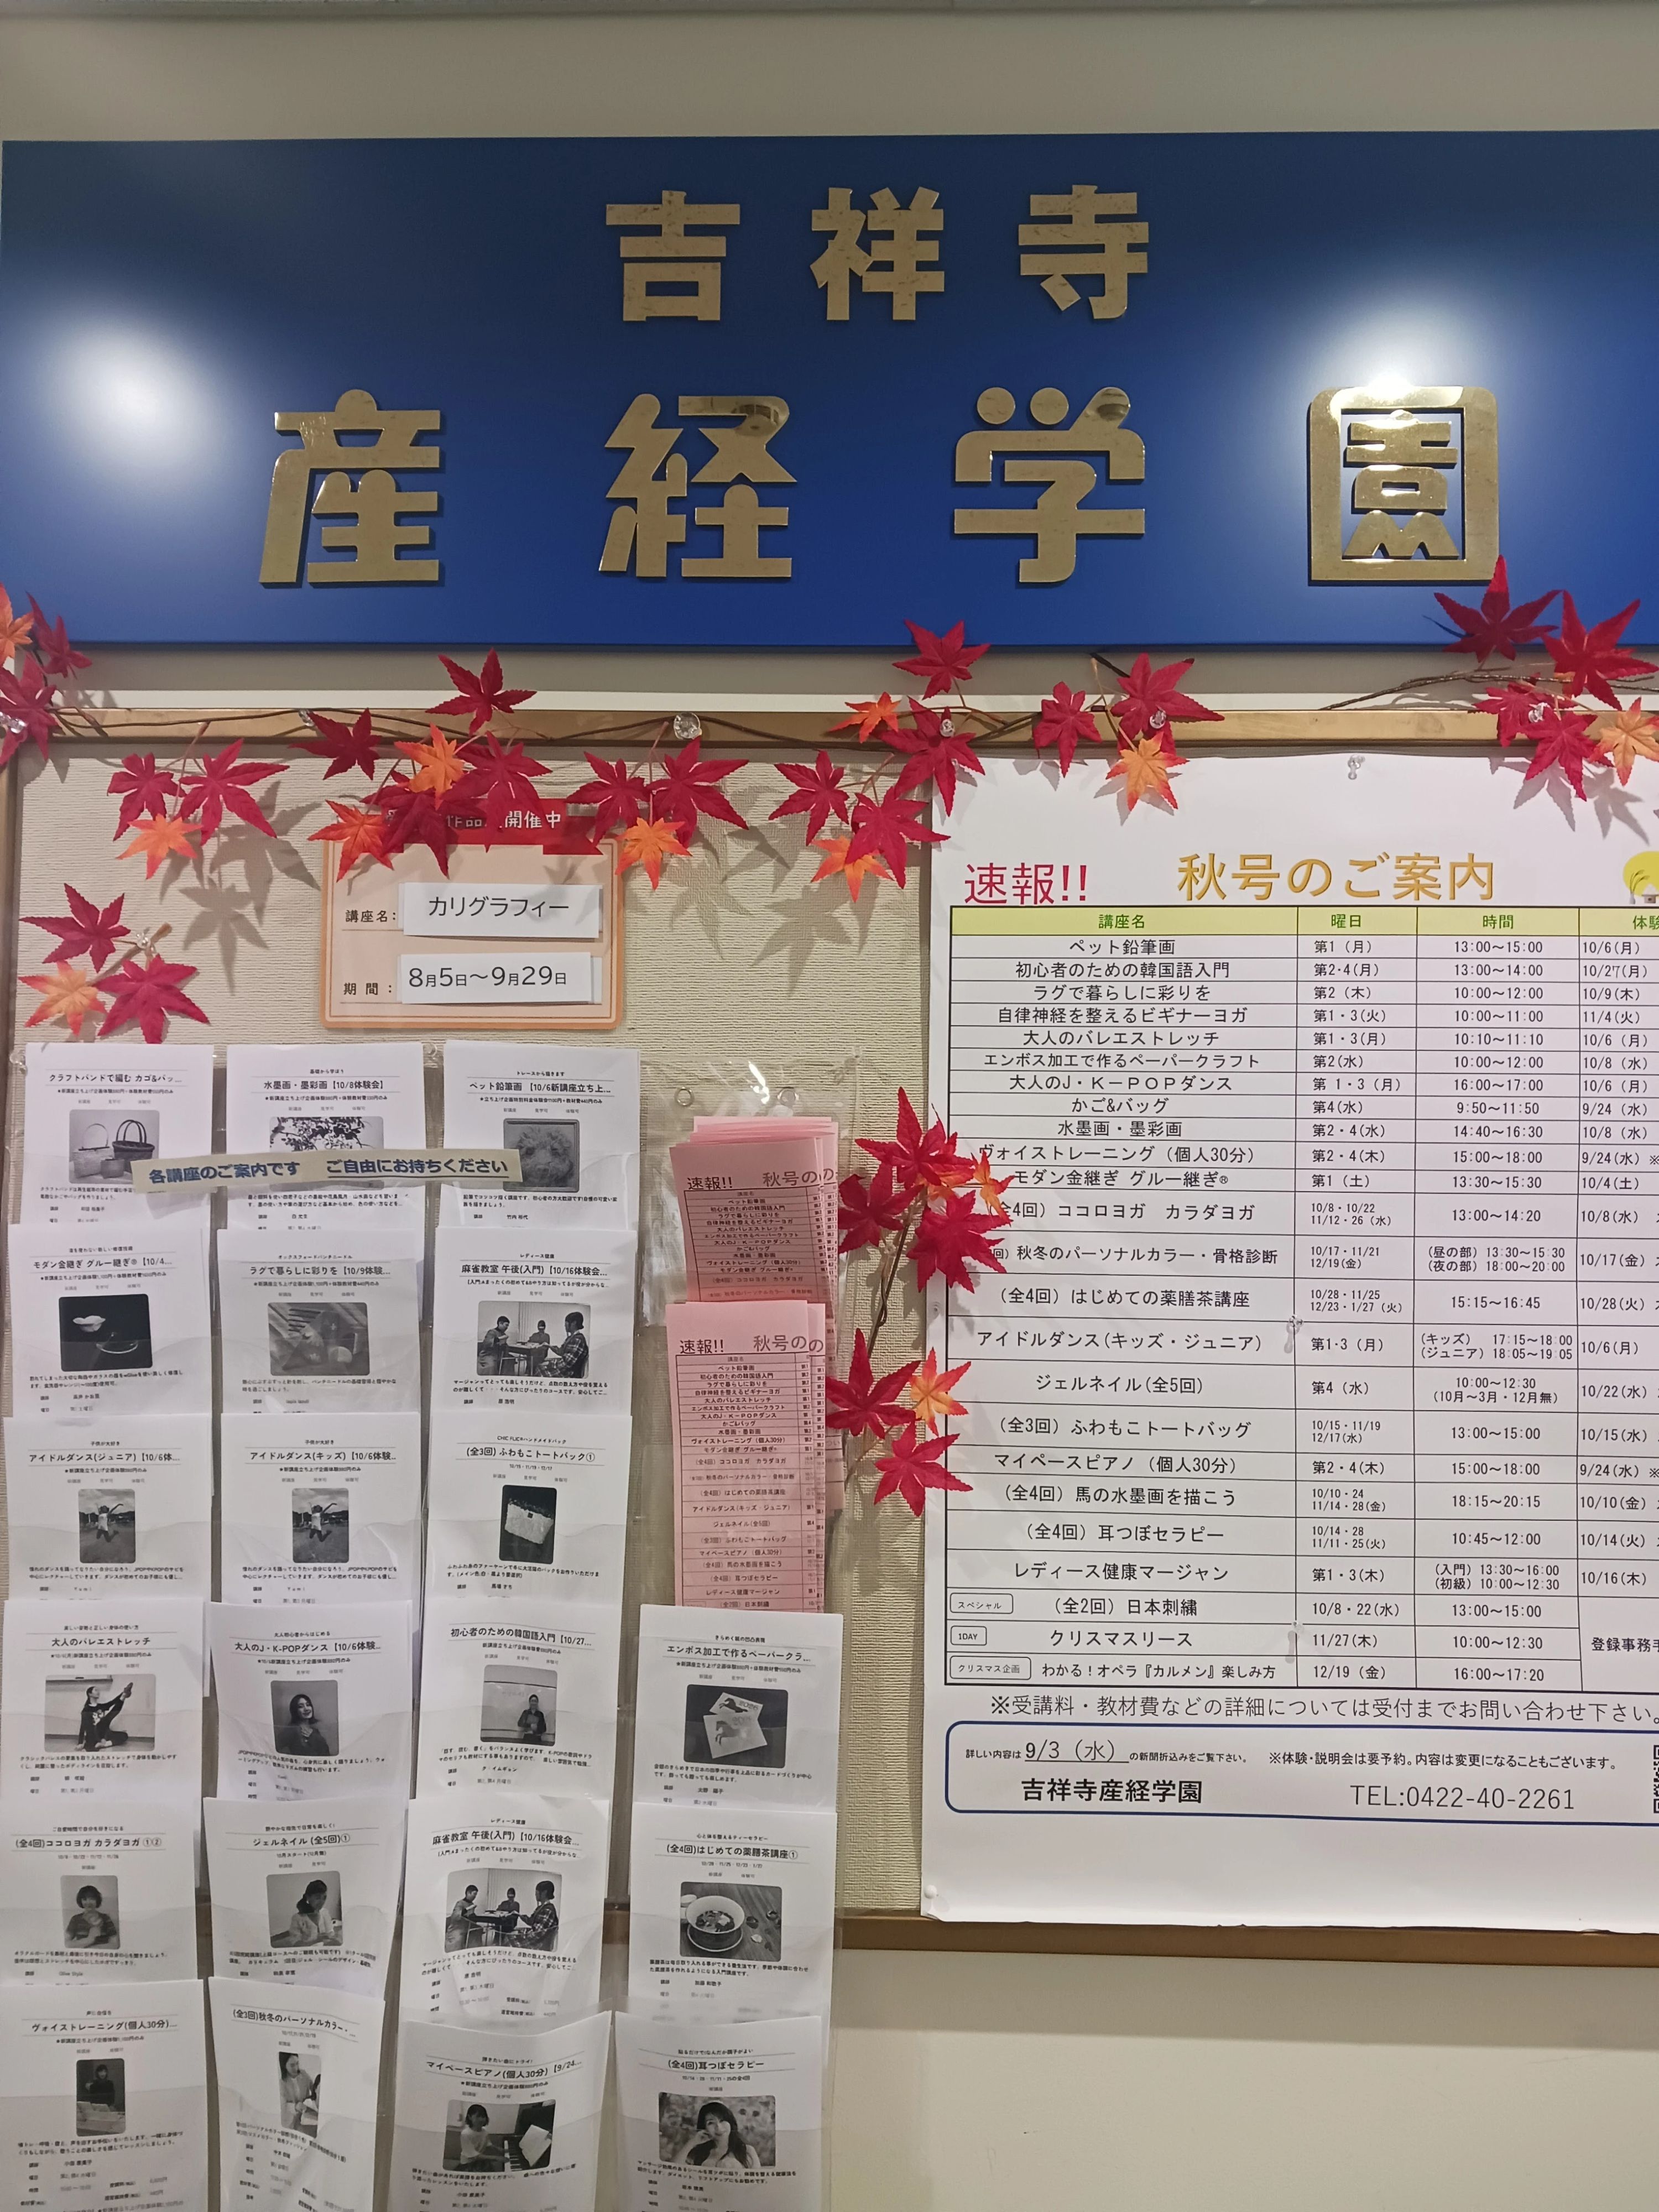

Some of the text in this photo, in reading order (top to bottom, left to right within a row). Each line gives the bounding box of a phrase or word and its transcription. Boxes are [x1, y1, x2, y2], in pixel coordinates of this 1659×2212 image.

[605, 183, 1150, 323] 吉祥寺
[259, 381, 1501, 585] 産経学園
[964, 851, 1494, 905] 速報!! 秋号のご案内
[429, 896, 569, 917] カリグラフィー
[1098, 914, 1145, 929] 講座名
[1331, 914, 1361, 928] 曜日
[1483, 915, 1514, 928] 時間
[1070, 939, 1640, 956] ペット鉛筆画 第1（月） 13:00～15:00 10/6(月)
[409, 966, 566, 988] 8月5日～9月29日
[1015, 962, 1647, 978] 初心者のための韓国語入門 第2・4(月) 13:00～14:00 10/27(月)
[1034, 985, 1640, 1001] ラグで暮らしに彩りを 第2（木） 10:00～12:00 10/9(木)
[999, 1008, 1640, 1024] 自律神経を整えるビギナーヨガ 第1・3(火) 10:00～11:00 11/4(火)
[1023, 1030, 1647, 1047] 大人のバレエストレッチ 第1・3(月) 10:10～11:10 10/6（月）
[984, 1053, 1647, 1071] エンボス加工で作るペーパークラフト 第2(水) 10:00～12:00 10/8（水）
[1454, 1079, 1543, 1091] 16:00～17:00
[1583, 1080, 1647, 1093] 10/6（月）
[1072, 1097, 1647, 1117] かご&バッグ 第4(水) 9:50～11:50 9/24（水）
[1057, 1120, 1647, 1140] 水墨画・墨彩画 第2・4(水) 14:40～16:30 10/8（水）
[979, 1144, 1640, 1166] ヴォイストレーニング（個人30分） 第2・4(木) 15:00～18:00 9/24(水)
[149, 1158, 508, 1185] 各講座のご案内です ご自由にお持ちください
[1014, 1169, 1119, 1186] モダン金継ぎ
[1312, 1174, 1369, 1188] 第1（土）
[1453, 1176, 1542, 1188] 13:30～15:30
[1582, 1176, 1639, 1190] 10/4(土)
[687, 1177, 733, 1190] 速報!!
[1166, 1204, 1255, 1220] カラダヨガ
[1311, 1202, 1375, 1214] 10/8・10/22
[1452, 1209, 1541, 1222] 13:00～14:20
[1581, 1210, 1638, 1224] 10/8(水)
[1311, 1215, 1391, 1227] 11/12・26（水）
[993, 1244, 1279, 1265] 回）秋冬のパーソナルカラー・骨格診断
[1311, 1246, 1379, 1258] 10/17・11/21
[1580, 1254, 1645, 1267] 10/17(金)
[1311, 1258, 1361, 1269] 12/19(金)
[461, 1265, 499, 1274] 麻雀教室
[1311, 1290, 1380, 1301] 10/28・11/25
[1452, 1296, 1540, 1309] 15:15～16:45
[1580, 1297, 1645, 1311] 10/28(火)
[1311, 1301, 1402, 1313] 12/23・1/27（火）
[680, 1339, 724, 1354] 速報!!
[978, 1331, 1261, 1352] アイドルダンス(キッズ・ジュニア)
[1311, 1338, 1383, 1352] 第1・3（月）
[1493, 1334, 1573, 1345] 17:15～18:00
[1581, 1342, 1638, 1355] 10/6(月)
[1036, 1375, 1647, 1399] ジェルネイル(全5回) 第4（水） 10:00～12:30 10/22(水)
[1434, 1391, 1558, 1404] （10月～3月・12月無）
[1312, 1420, 1381, 1432] 10/15・11/19
[1452, 1427, 1541, 1440] 13:00～15:00
[1581, 1428, 1647, 1442] 10/15(水)
[1312, 1432, 1362, 1444] 12/17(水)
[994, 1453, 1639, 1478] マイペースピアノ（個人30分） 第2・4(木) 15:00～18:00 9/24(水)
[1312, 1488, 1364, 1499] 10/10・24
[1452, 1495, 1541, 1508] 18:15～20:15
[1580, 1496, 1646, 1510] 10/10(金)
[1313, 1500, 1386, 1512] 11/14・28(金)
[1312, 1526, 1364, 1536] 10/14・28
[1452, 1532, 1541, 1545] 10:45～12:00
[1580, 1533, 1645, 1548] 10/14(火)
[1312, 1538, 1386, 1550] 11/11・25(火)
[1015, 1562, 1228, 1581] レディース健康マージャン
[1312, 1568, 1384, 1582] 第1・3(木)
[1581, 1572, 1646, 1586] 10/16(木)
[958, 1601, 1002, 1610] スペシャル
[1312, 1602, 1399, 1617] 10/8・22(水)
[1452, 1604, 1542, 1618] 13:00～15:00
[51, 1637, 151, 1647] 大人のバレエストレッチ
[1050, 1630, 1192, 1647] クリスマスリース
[1313, 1634, 1378, 1648] 11/27(木)
[1453, 1636, 1543, 1650] 10:00～12:30
[958, 1663, 1544, 1682] クリスマス企画 わかる！オペラ『カルメン』楽しみ方 12/19（金） 16:00～17:20
[966, 1749, 1021, 1759] 詳しい内容は
[1129, 1752, 1246, 1763] の新聞折込みをご覧下さい。
[1021, 1777, 1574, 1809] 吉祥寺産経学園 TEL:0422-40-2261
[253, 1838, 307, 1846] ジェルネイル
